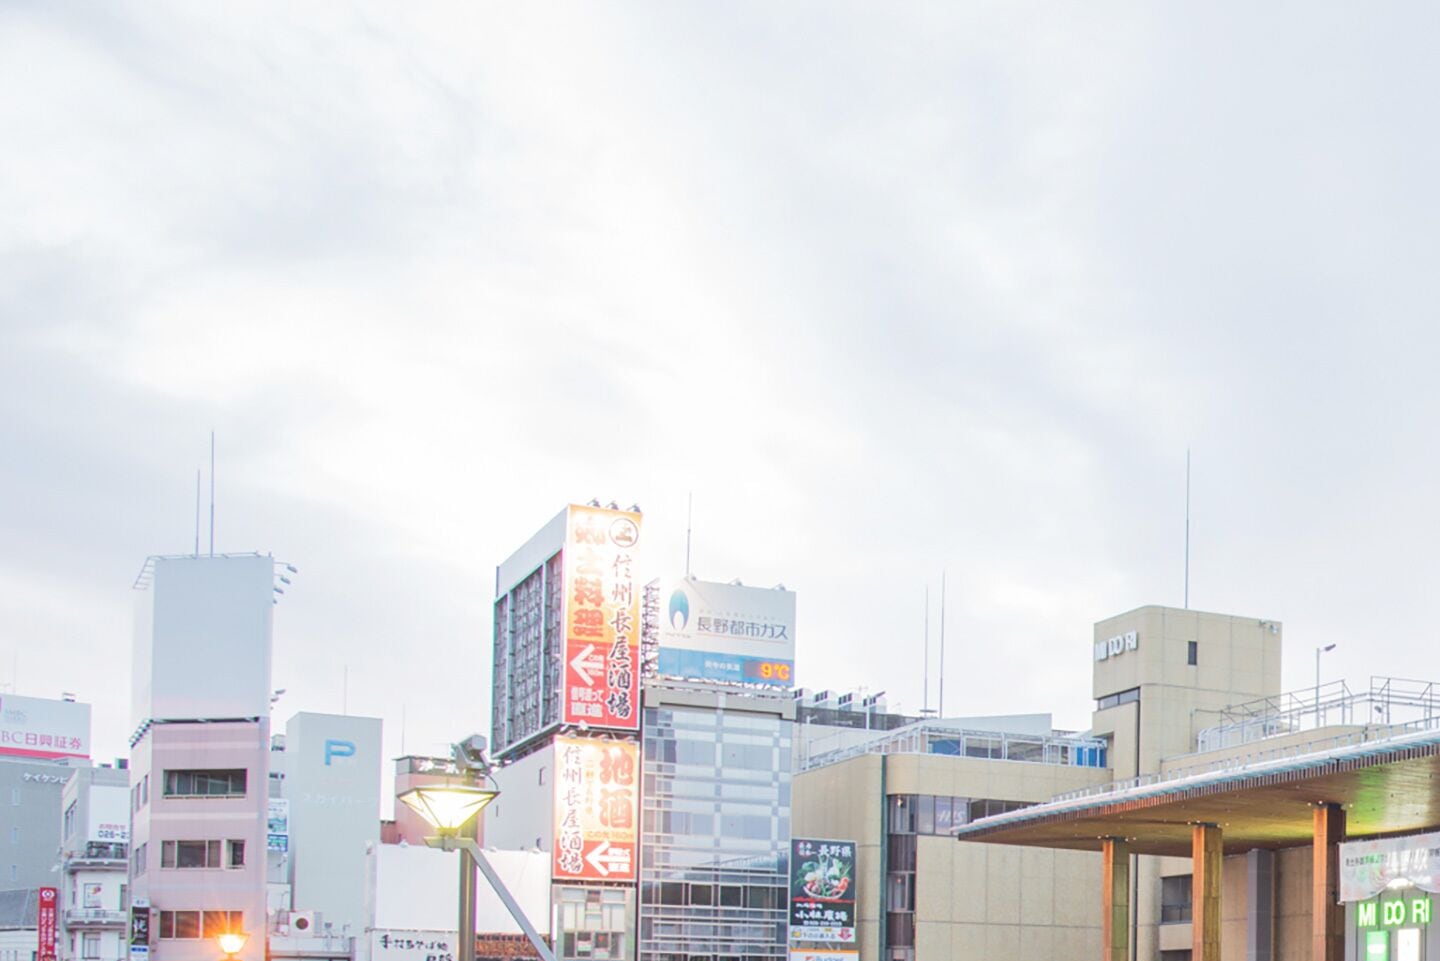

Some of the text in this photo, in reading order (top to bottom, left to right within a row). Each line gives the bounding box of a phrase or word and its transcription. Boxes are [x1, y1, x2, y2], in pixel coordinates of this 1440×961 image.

[607, 553, 633, 718] 信州長屋酒場
[697, 617, 788, 640] 長野都市ガス
[324, 740, 356, 766] P
[600, 748, 634, 829] 地酒
[560, 746, 584, 873] 信州長屋酒場
